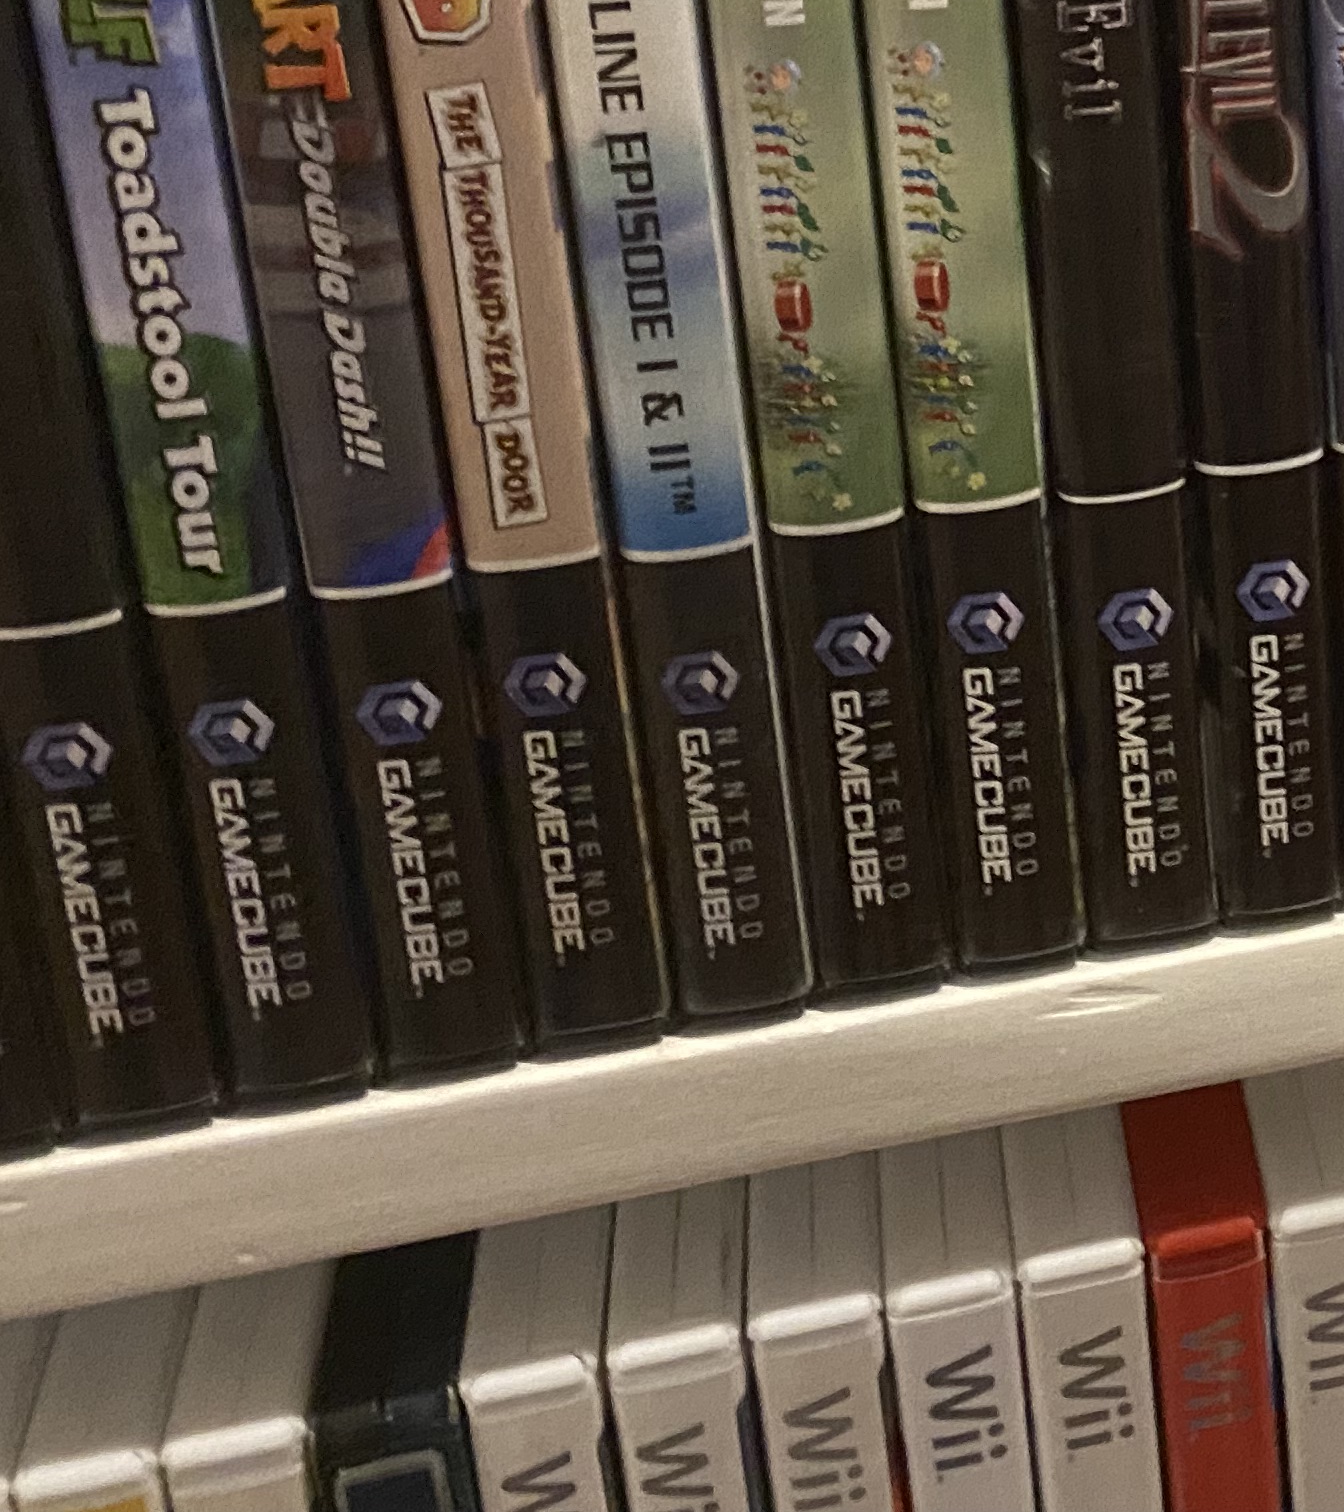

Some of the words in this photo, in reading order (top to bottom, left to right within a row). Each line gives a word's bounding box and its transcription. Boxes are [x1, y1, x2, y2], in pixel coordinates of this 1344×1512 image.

[601, 131, 676, 344] EPISODE
[96, 88, 209, 422] Toadstool
[160, 435, 225, 574] Tour
[446, 93, 483, 152] THE
[494, 431, 535, 516] DOOR
[636, 358, 680, 375] I
[641, 392, 686, 428] &
[997, 666, 1039, 877] NINTENDO
[925, 1344, 1008, 1470] Wii
[1059, 1325, 1135, 1451] Wii
[1178, 1313, 1255, 1433] Wii
[783, 1387, 867, 1511] Wii
